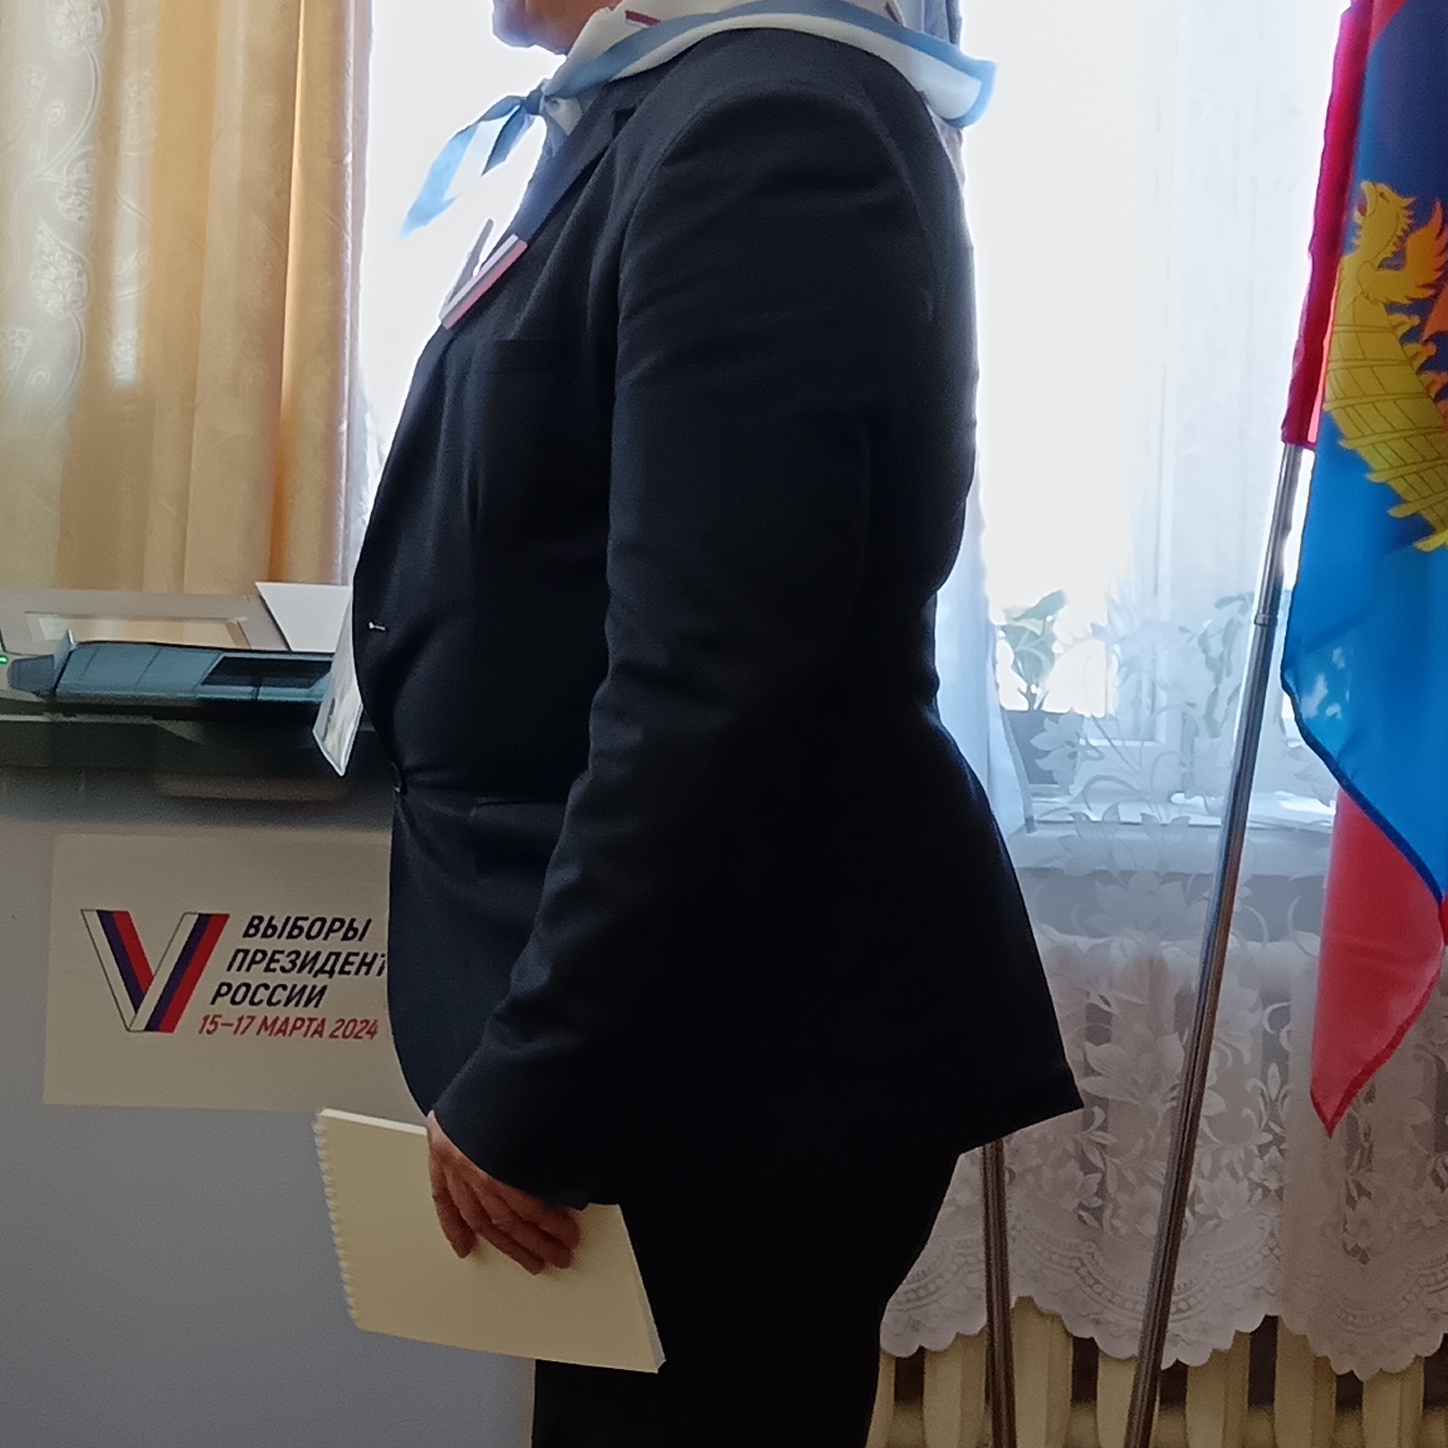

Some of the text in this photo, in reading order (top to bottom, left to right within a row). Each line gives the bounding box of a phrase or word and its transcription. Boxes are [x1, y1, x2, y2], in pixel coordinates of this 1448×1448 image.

[242, 914, 373, 942] ВЫБОРЫ
[210, 982, 328, 1009] РОССИИ
[256, 1015, 327, 1039] МАРТА
[329, 1018, 380, 1040] 2024
